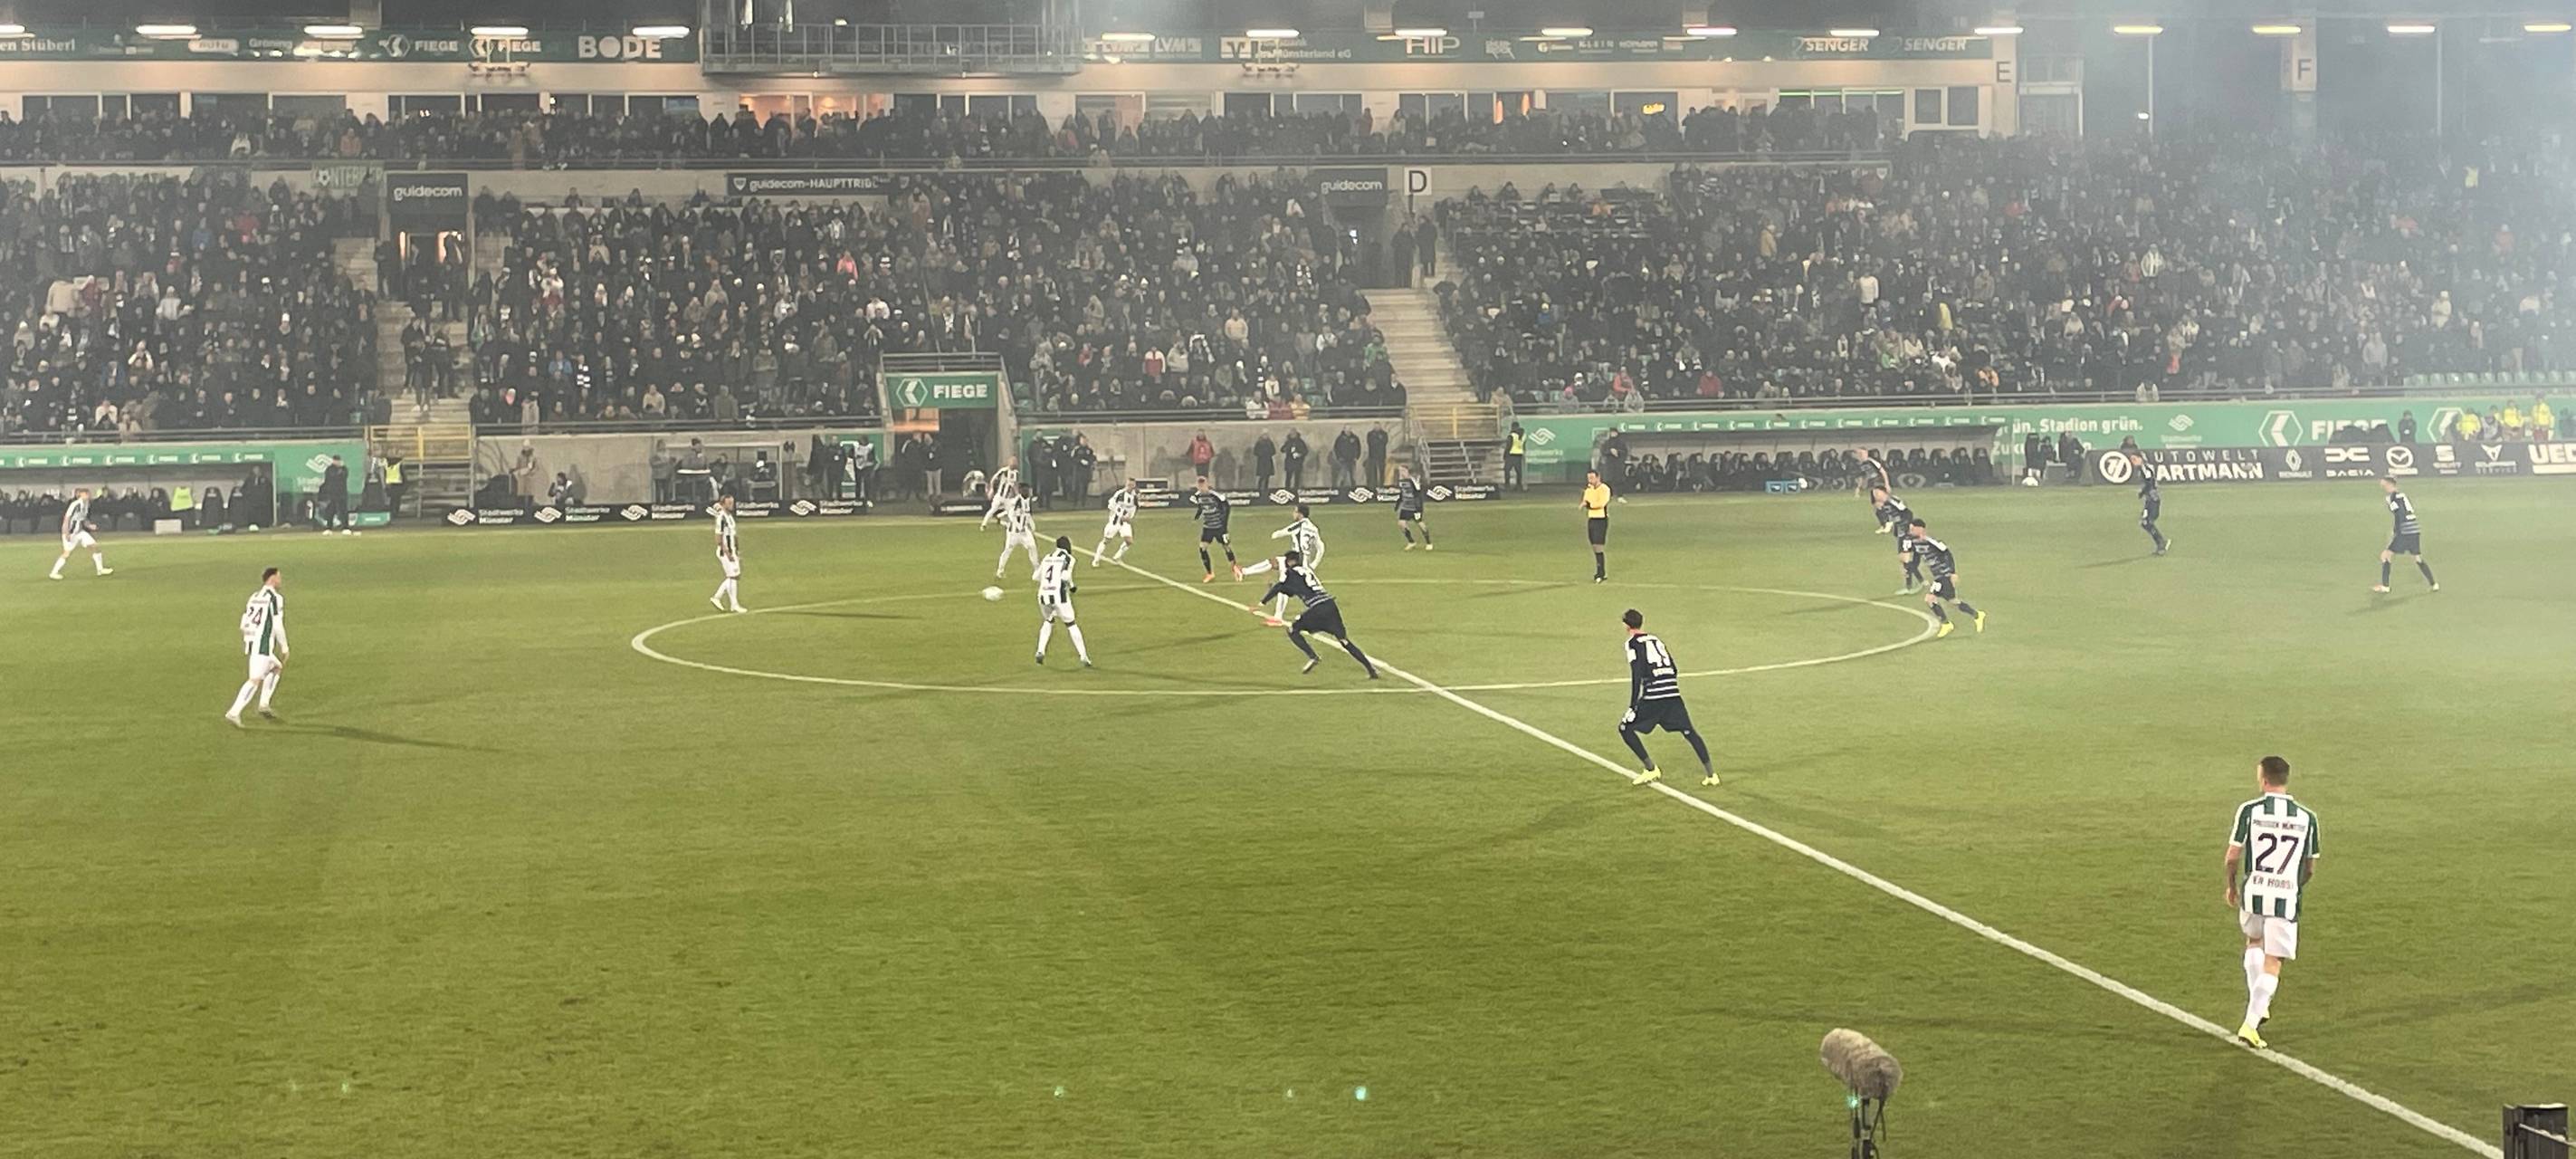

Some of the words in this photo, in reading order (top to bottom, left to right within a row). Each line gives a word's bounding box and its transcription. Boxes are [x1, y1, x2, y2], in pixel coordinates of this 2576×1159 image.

[22, 38, 76, 52] Stüberl
[415, 40, 458, 53] FIEGE
[578, 35, 663, 59] BODE
[1806, 37, 1870, 52] SENGER
[1904, 37, 1967, 52] SENGER
[1997, 61, 2012, 83] E
[2298, 59, 2313, 80] F
[1321, 180, 1383, 196] guidecom
[1408, 170, 1427, 193] D
[394, 185, 463, 201] guidecom
[933, 384, 987, 399] FIEGE
[2040, 417, 2098, 434] Stadion
[2102, 417, 2142, 435] grün.
[2150, 462, 2264, 482] ARTMANN
[2256, 833, 2299, 875] 27
